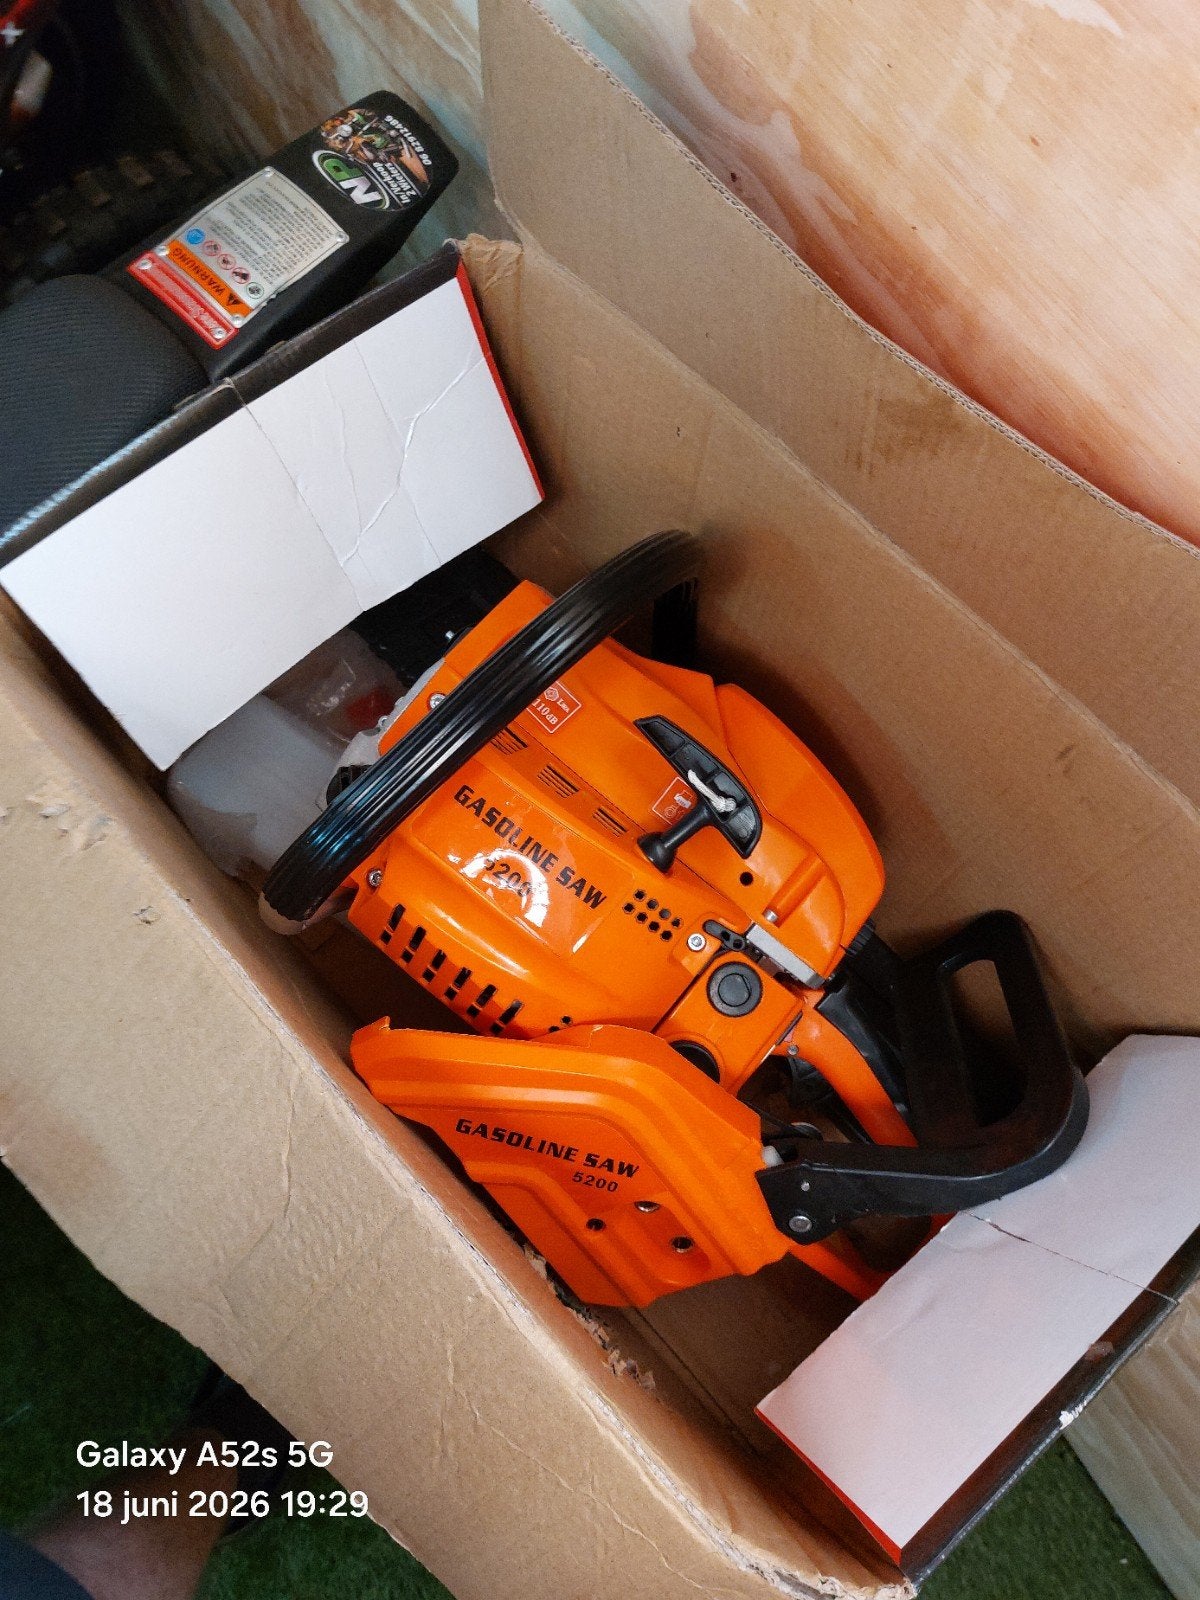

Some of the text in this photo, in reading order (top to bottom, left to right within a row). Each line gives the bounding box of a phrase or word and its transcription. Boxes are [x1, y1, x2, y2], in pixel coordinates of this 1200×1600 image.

[384, 162, 411, 191] Wielers
[419, 153, 432, 166] 06
[323, 158, 383, 205] NP
[372, 161, 411, 204] In/Verkoop
[453, 784, 608, 910] GASOLINE SAW
[455, 1118, 640, 1179] GASOLINE SAW
[572, 1171, 619, 1193] 5200
